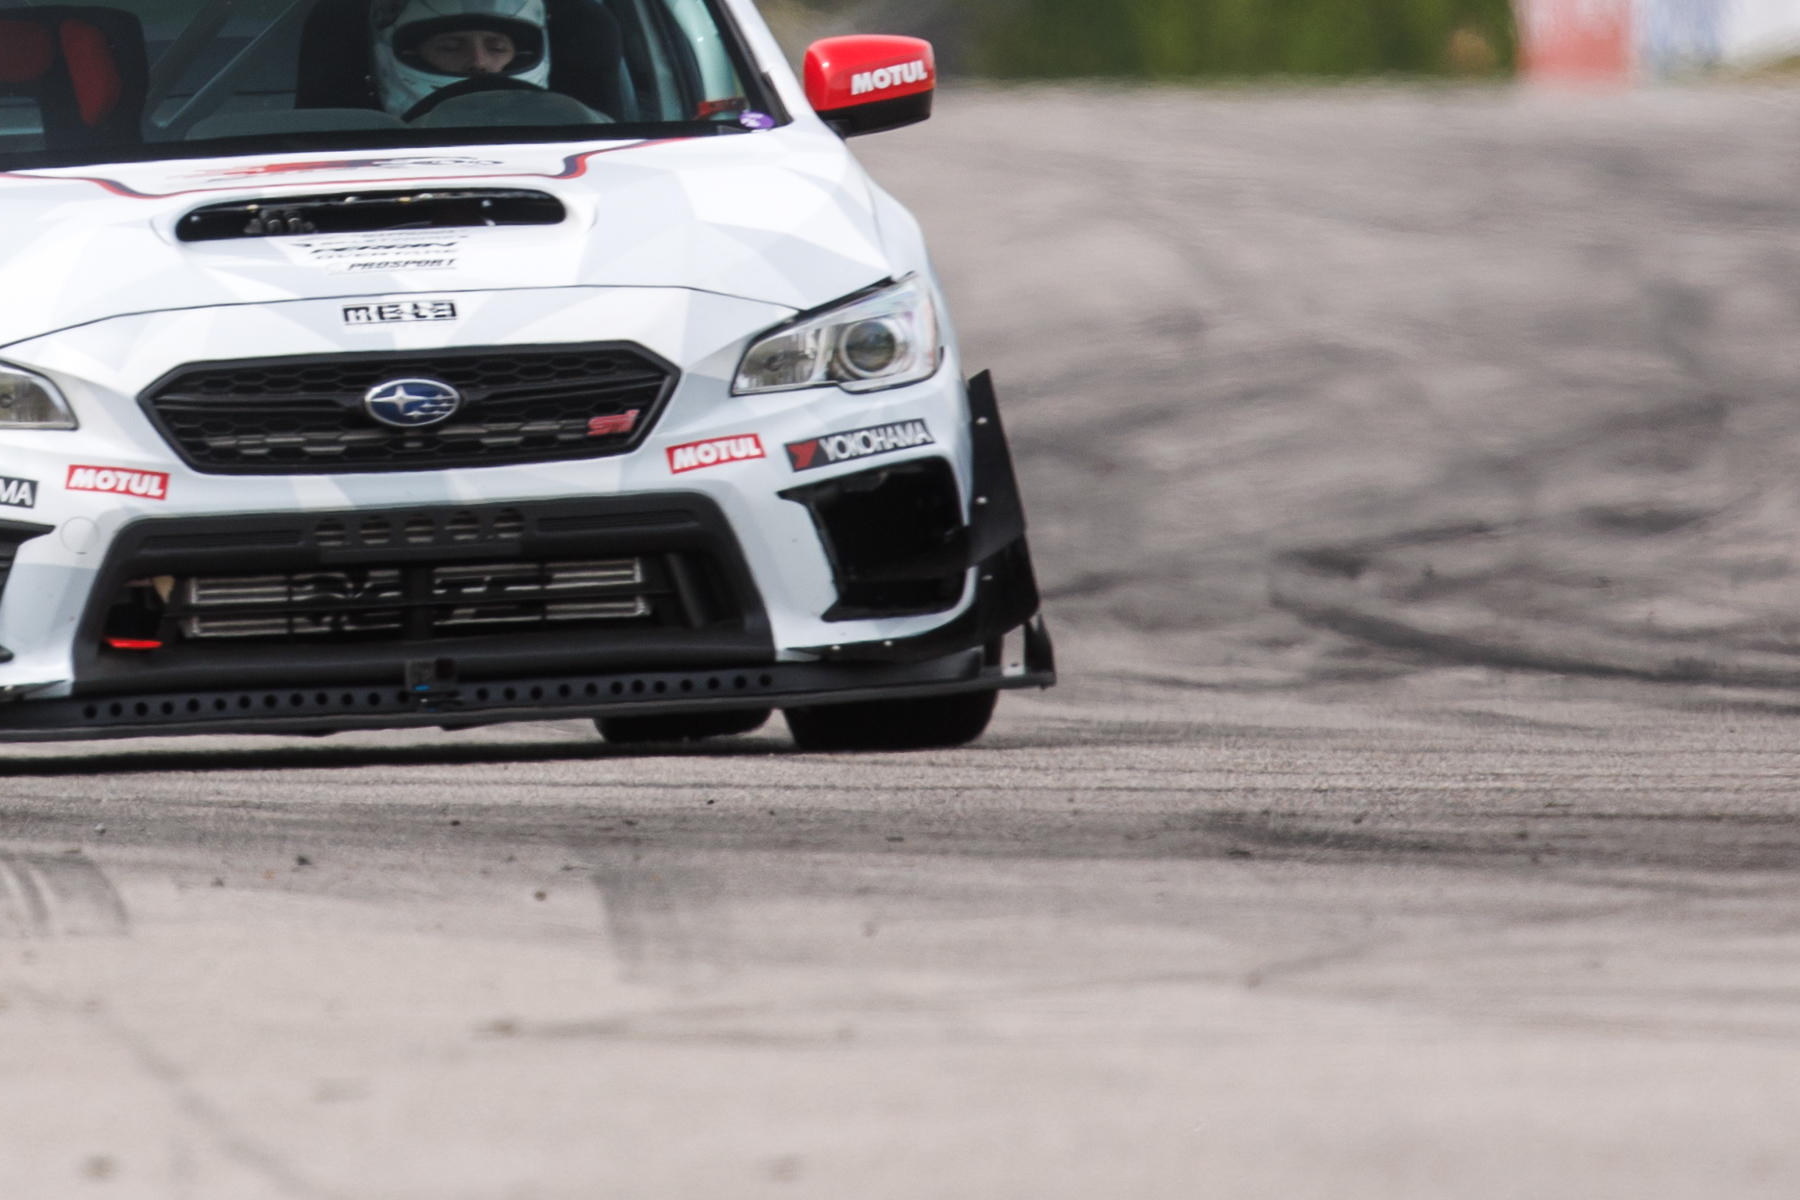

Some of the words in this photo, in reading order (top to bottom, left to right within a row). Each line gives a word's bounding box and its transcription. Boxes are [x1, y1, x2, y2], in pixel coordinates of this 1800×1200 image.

[851, 59, 928, 95] MOTUL
[348, 258, 459, 271] PROSPORT
[673, 436, 762, 471] MOTUL
[819, 422, 933, 461] YOKOHAMA
[68, 467, 164, 497] MOTUL
